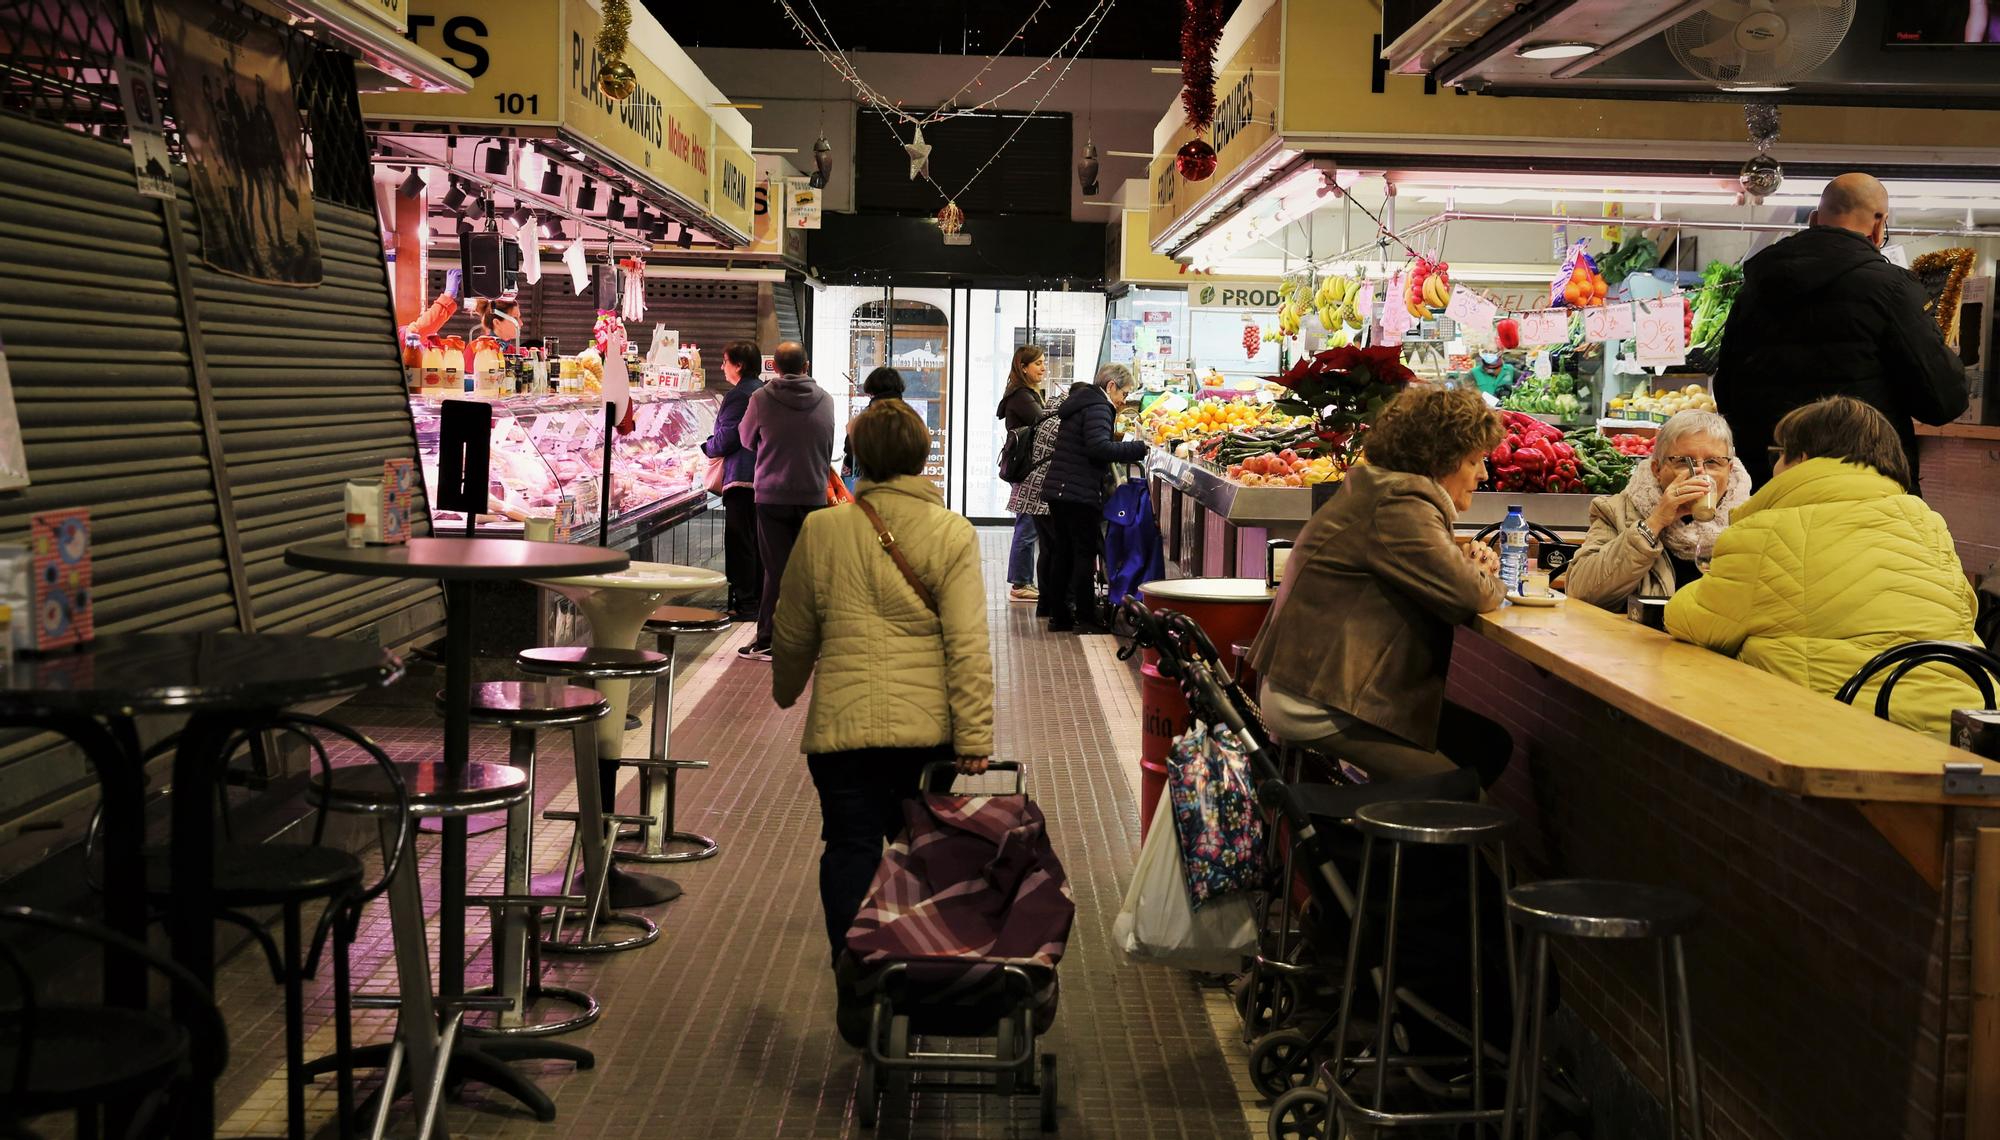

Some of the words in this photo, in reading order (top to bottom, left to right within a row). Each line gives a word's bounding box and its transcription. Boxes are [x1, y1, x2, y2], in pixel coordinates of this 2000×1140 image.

[494, 93, 538, 115] 101
[723, 159, 747, 211] AVIRAM
[1222, 289, 1287, 306] PROD
